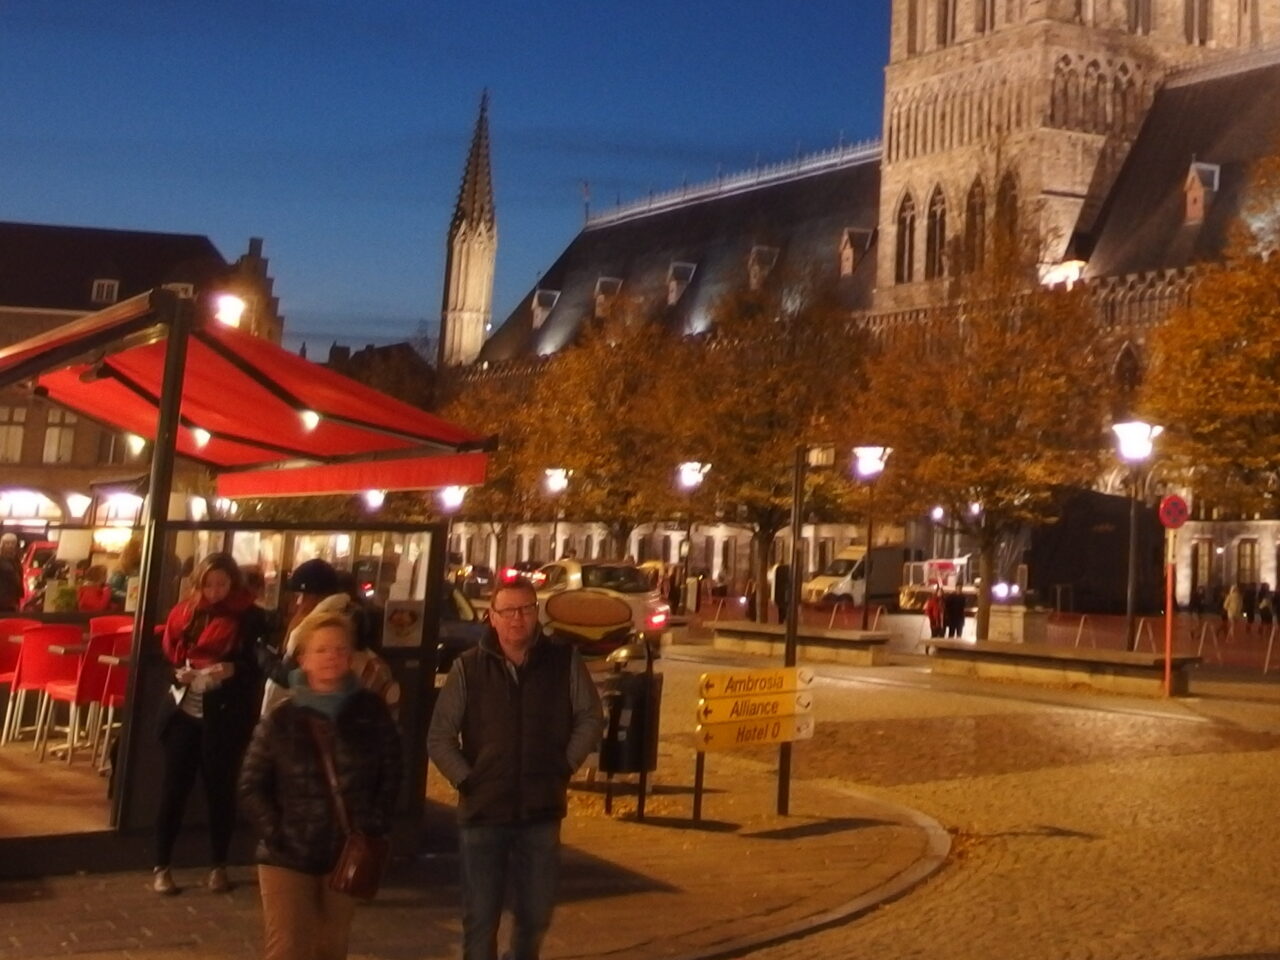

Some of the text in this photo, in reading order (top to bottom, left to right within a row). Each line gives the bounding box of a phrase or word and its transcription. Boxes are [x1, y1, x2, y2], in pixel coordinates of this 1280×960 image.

[725, 676, 784, 693] Ambrosia
[730, 701, 779, 718] Alliance
[736, 725, 768, 743] Hotel
